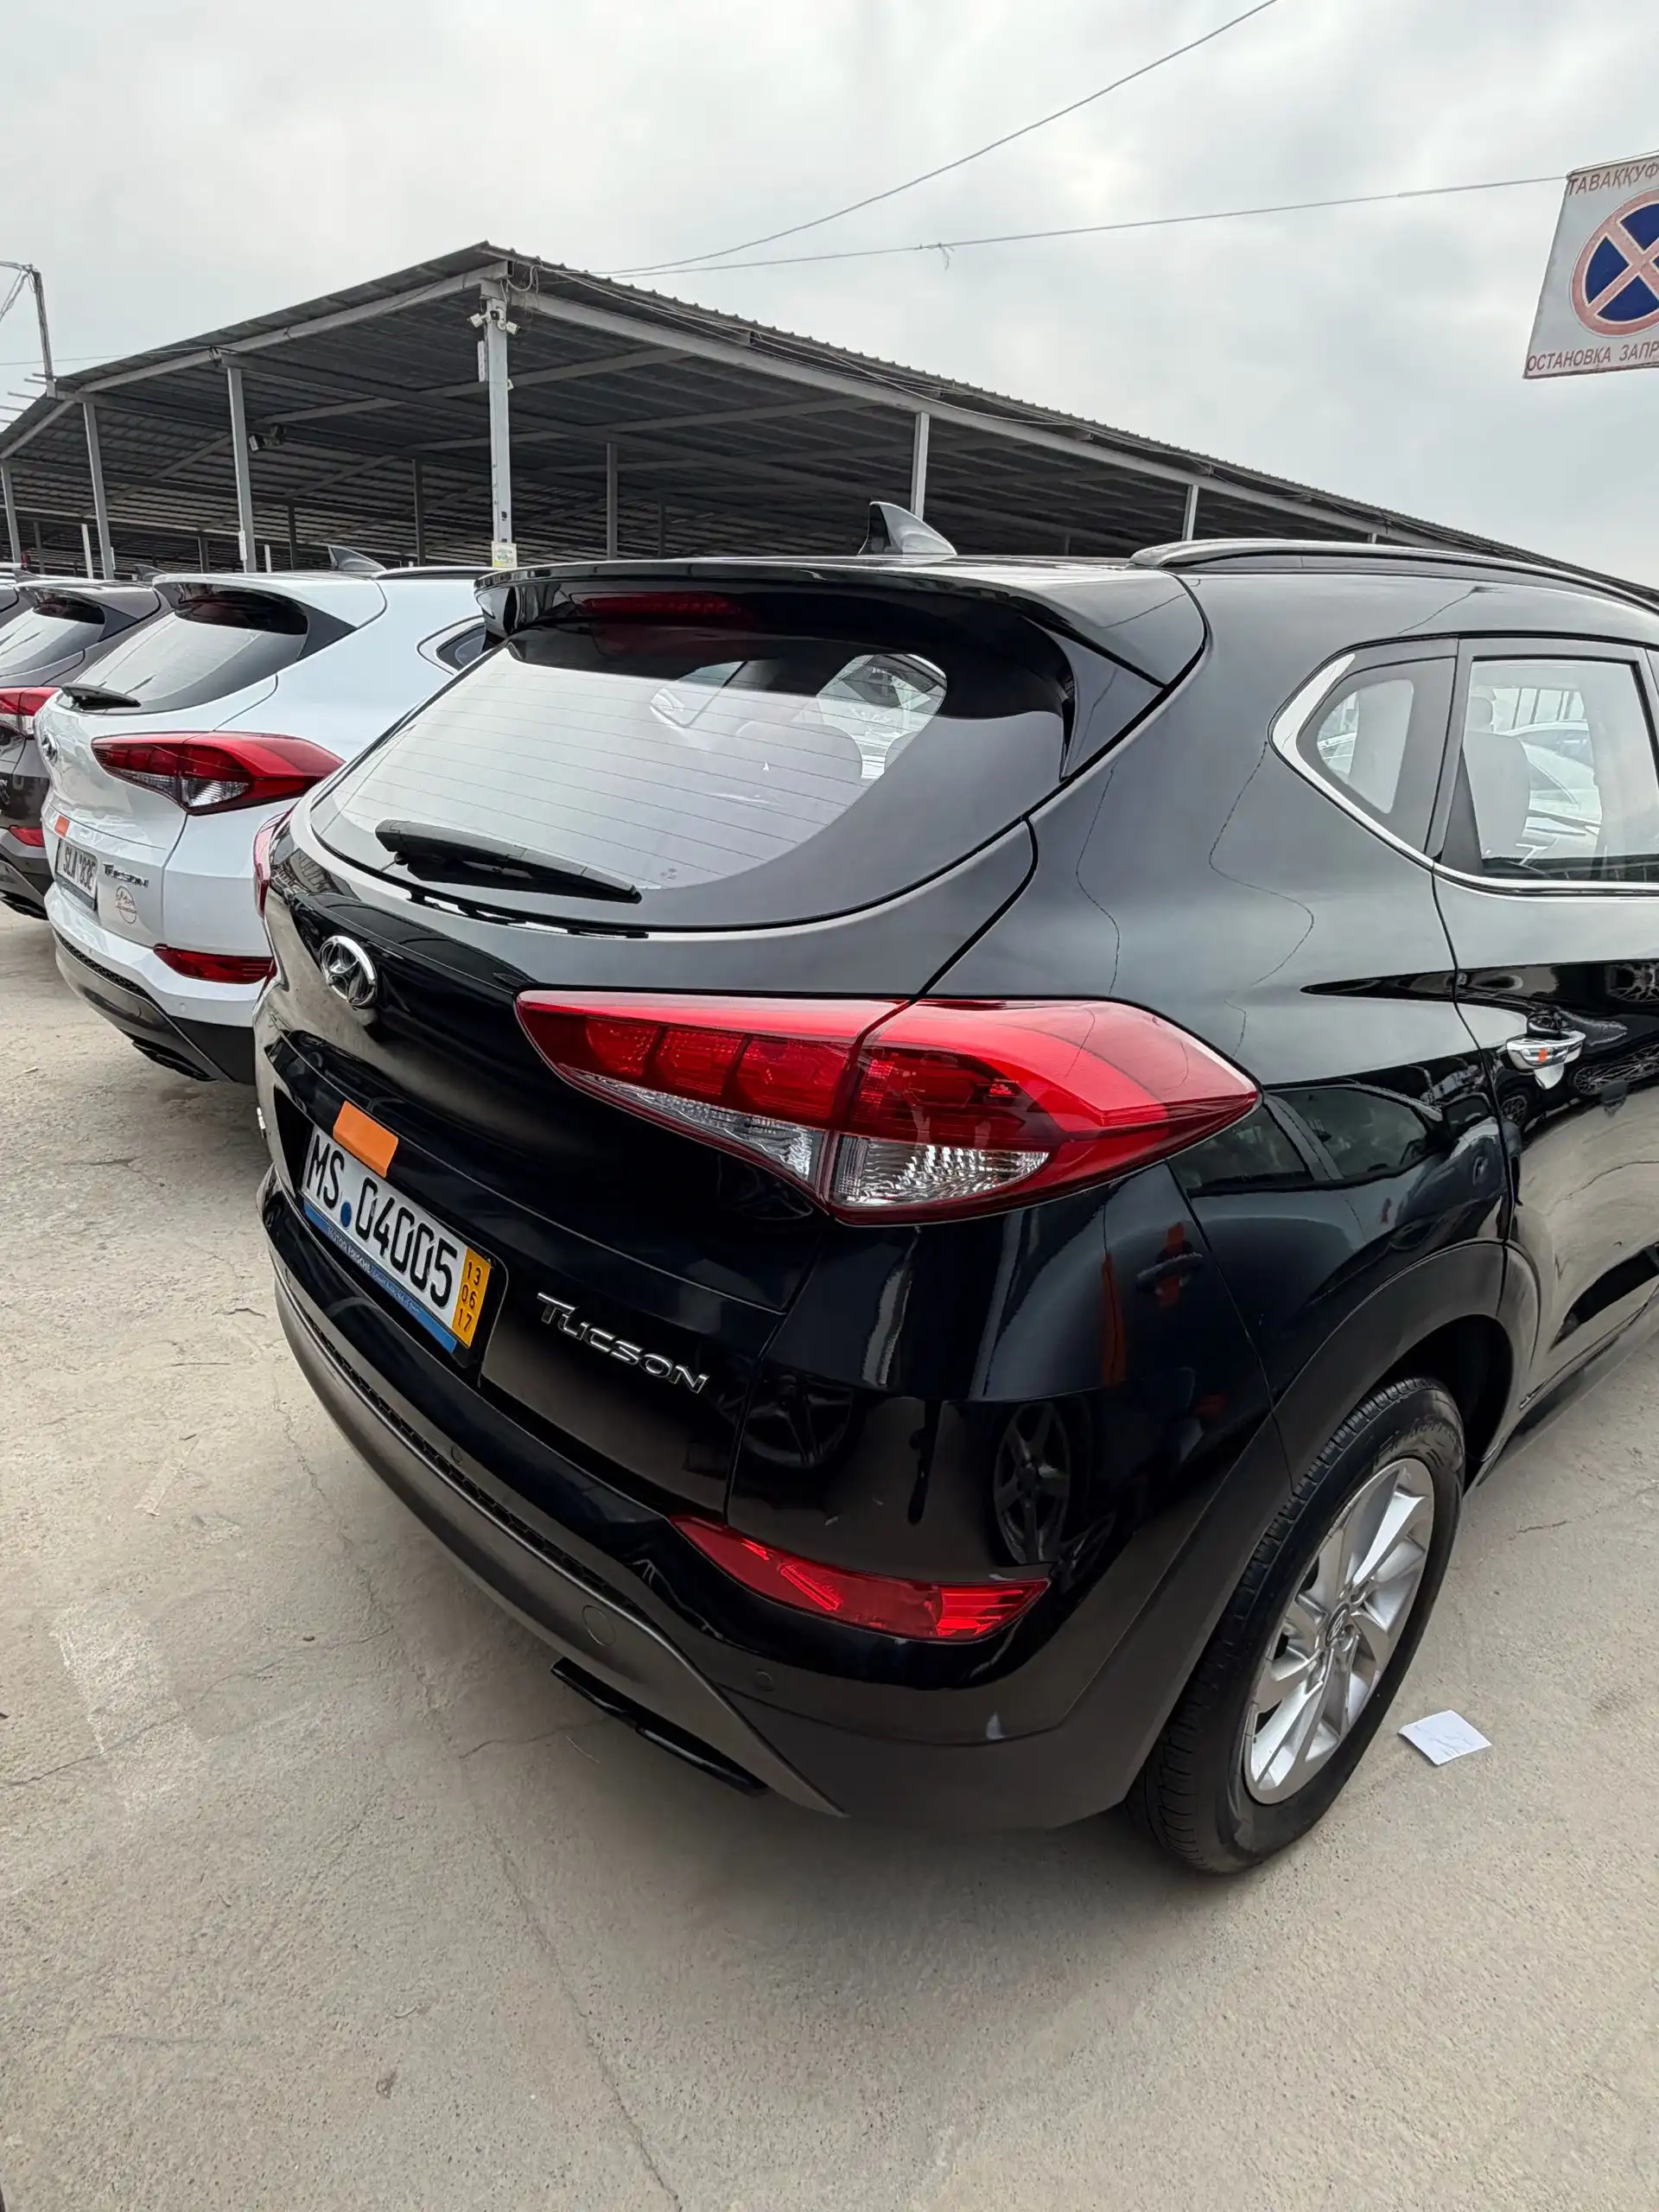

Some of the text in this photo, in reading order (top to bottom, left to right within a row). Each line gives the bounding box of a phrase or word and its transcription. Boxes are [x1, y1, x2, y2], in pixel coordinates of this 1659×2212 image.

[1527, 346, 1611, 372] ОСТАНОВКА
[307, 1135, 345, 1210] MS
[355, 1177, 458, 1308] 04005
[467, 1261, 481, 1286] 13
[461, 1284, 477, 1309] 06
[458, 1307, 473, 1332] 17
[537, 1292, 709, 1394] TUCSON
